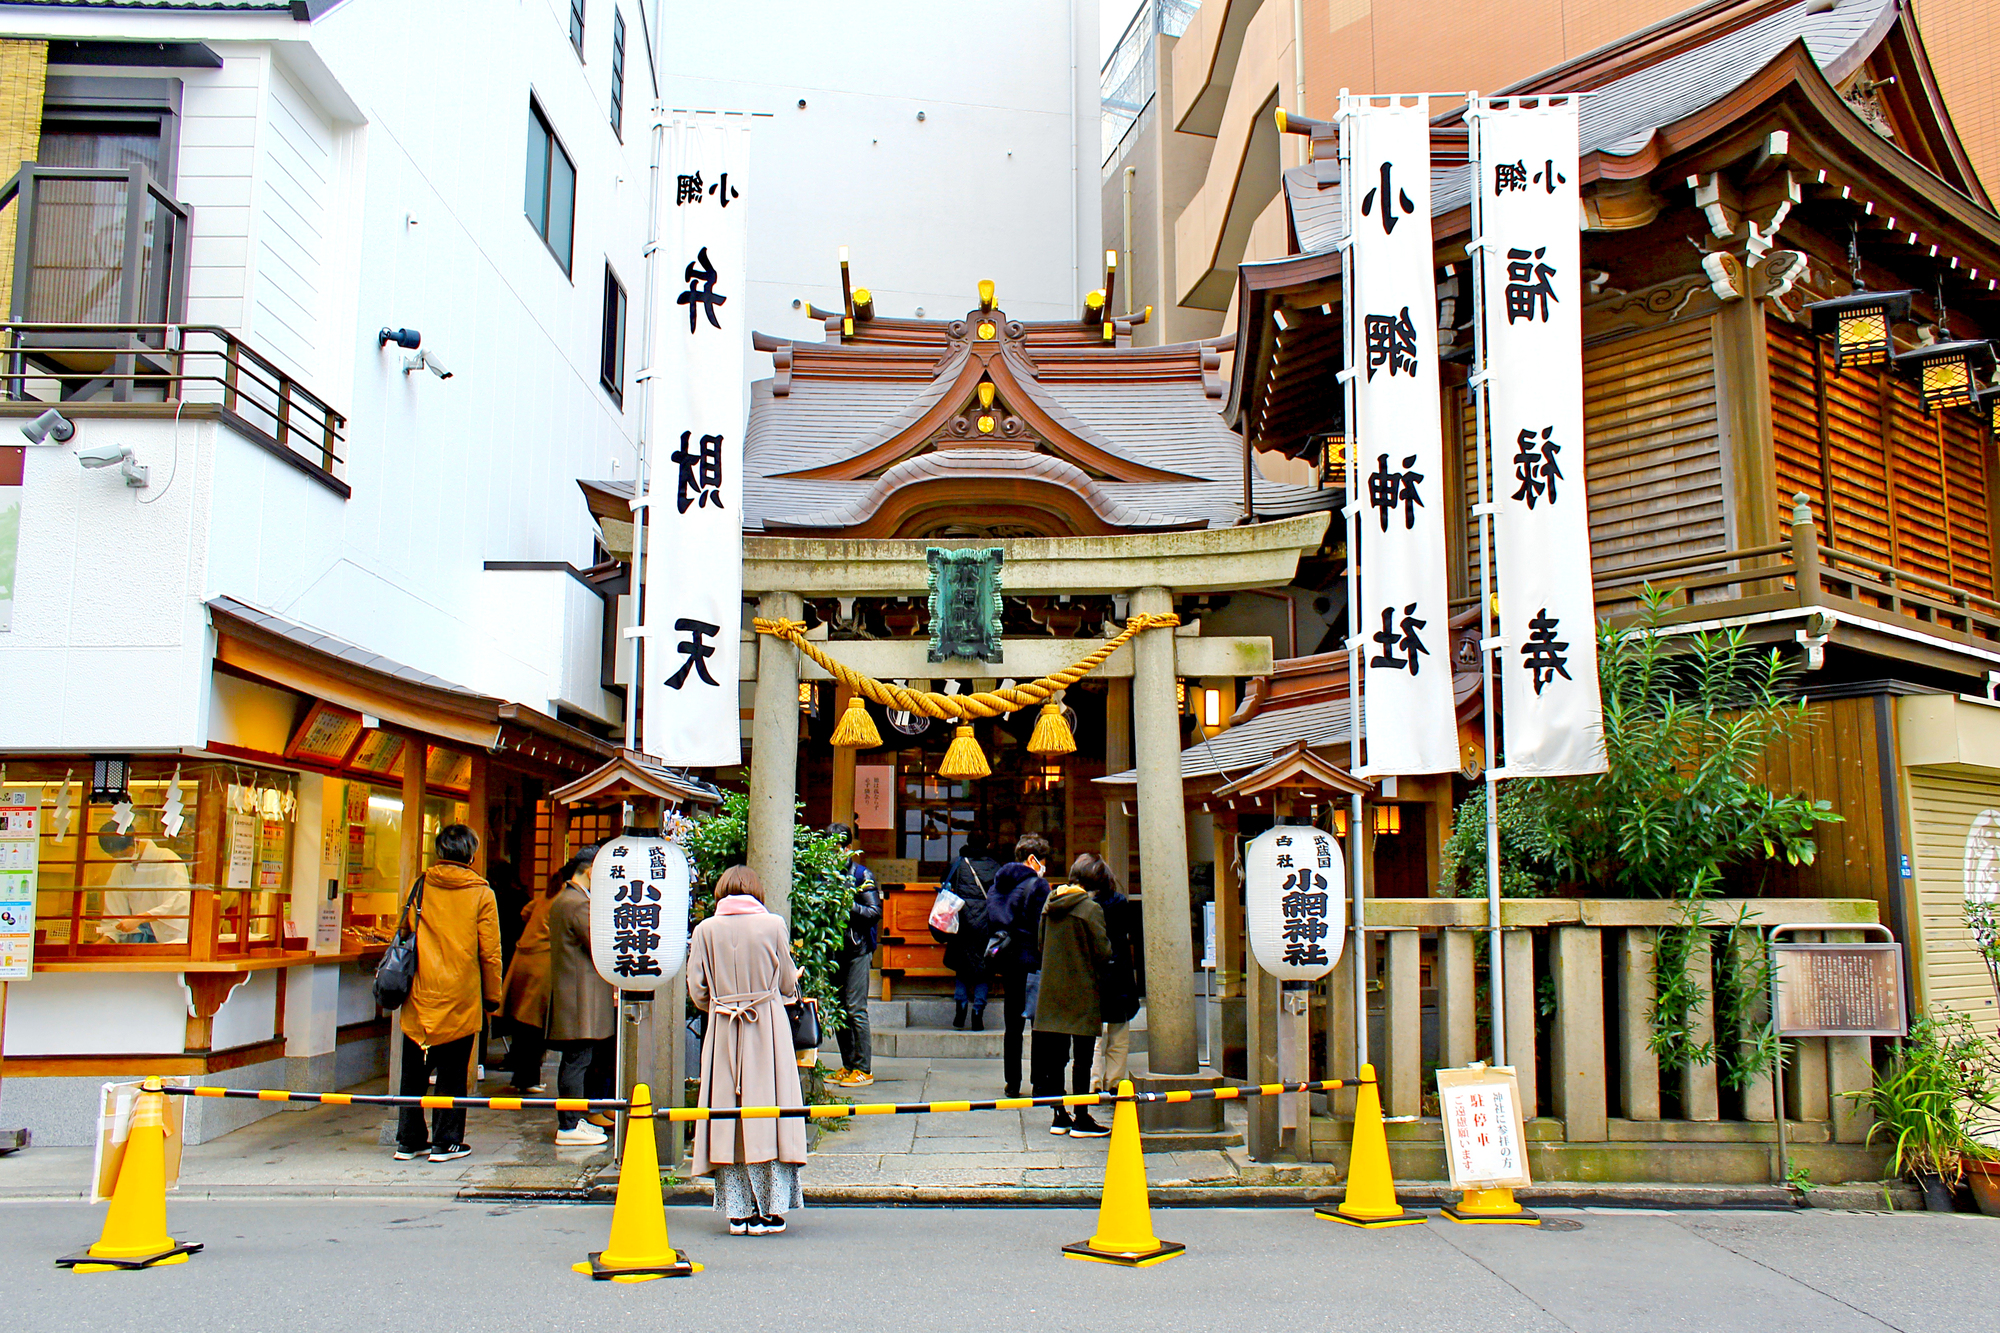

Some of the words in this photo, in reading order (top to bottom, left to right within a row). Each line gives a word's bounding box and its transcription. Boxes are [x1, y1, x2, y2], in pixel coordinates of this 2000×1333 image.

[612, 879, 663, 978] 小網神社
[1281, 868, 1330, 967] 小網神社
